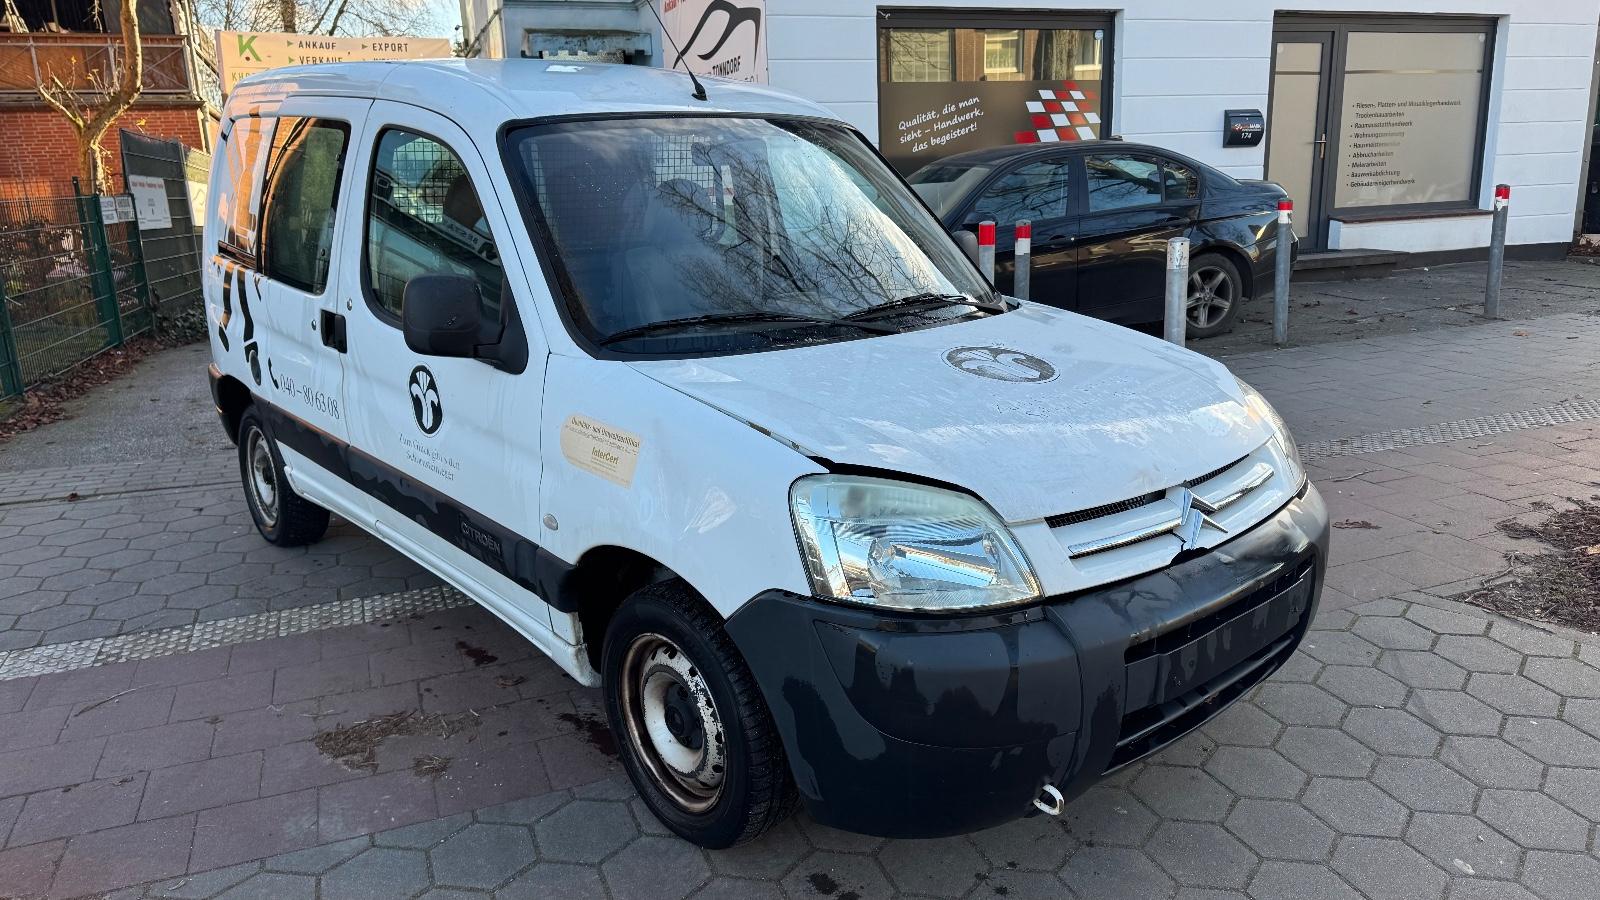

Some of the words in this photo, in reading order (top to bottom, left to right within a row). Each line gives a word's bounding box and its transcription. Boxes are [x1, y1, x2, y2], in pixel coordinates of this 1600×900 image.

[298, 40, 336, 50] ANKAUF
[372, 42, 408, 53] EXPORT
[898, 110, 940, 131] Qualität,
[942, 103, 957, 115] die
[959, 96, 980, 109] man
[900, 129, 922, 144] sieht
[933, 107, 984, 132] Handwerk,
[912, 141, 928, 153] das
[930, 121, 978, 146] begeistert!
[280, 373, 296, 398] 040
[460, 521, 501, 555] CITROËN
